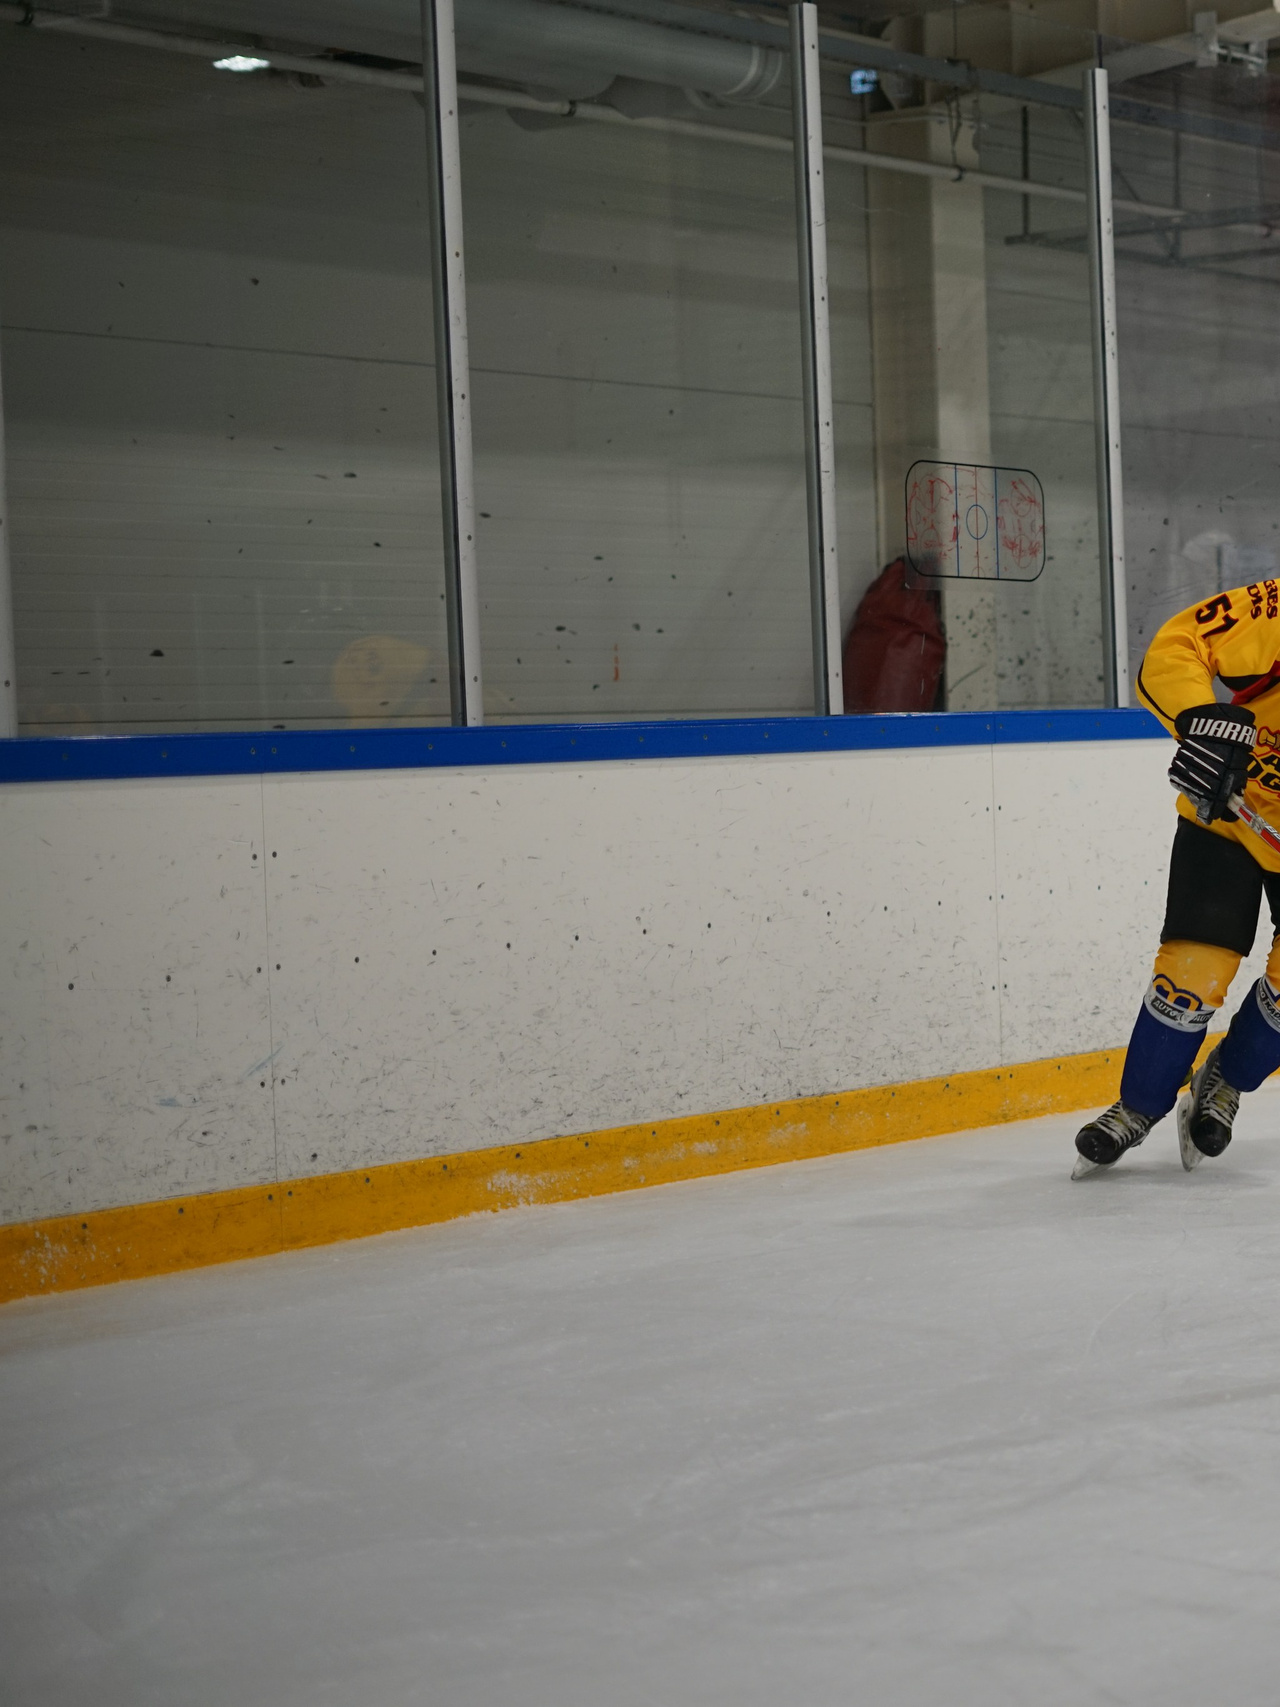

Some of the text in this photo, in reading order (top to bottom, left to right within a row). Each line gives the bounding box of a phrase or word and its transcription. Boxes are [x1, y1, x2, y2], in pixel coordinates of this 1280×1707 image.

[1195, 593, 1239, 640] 51
[1263, 579, 1278, 620] GRES
[1188, 717, 1257, 748] WARRI
[1153, 1000, 1177, 1018] AUTO
